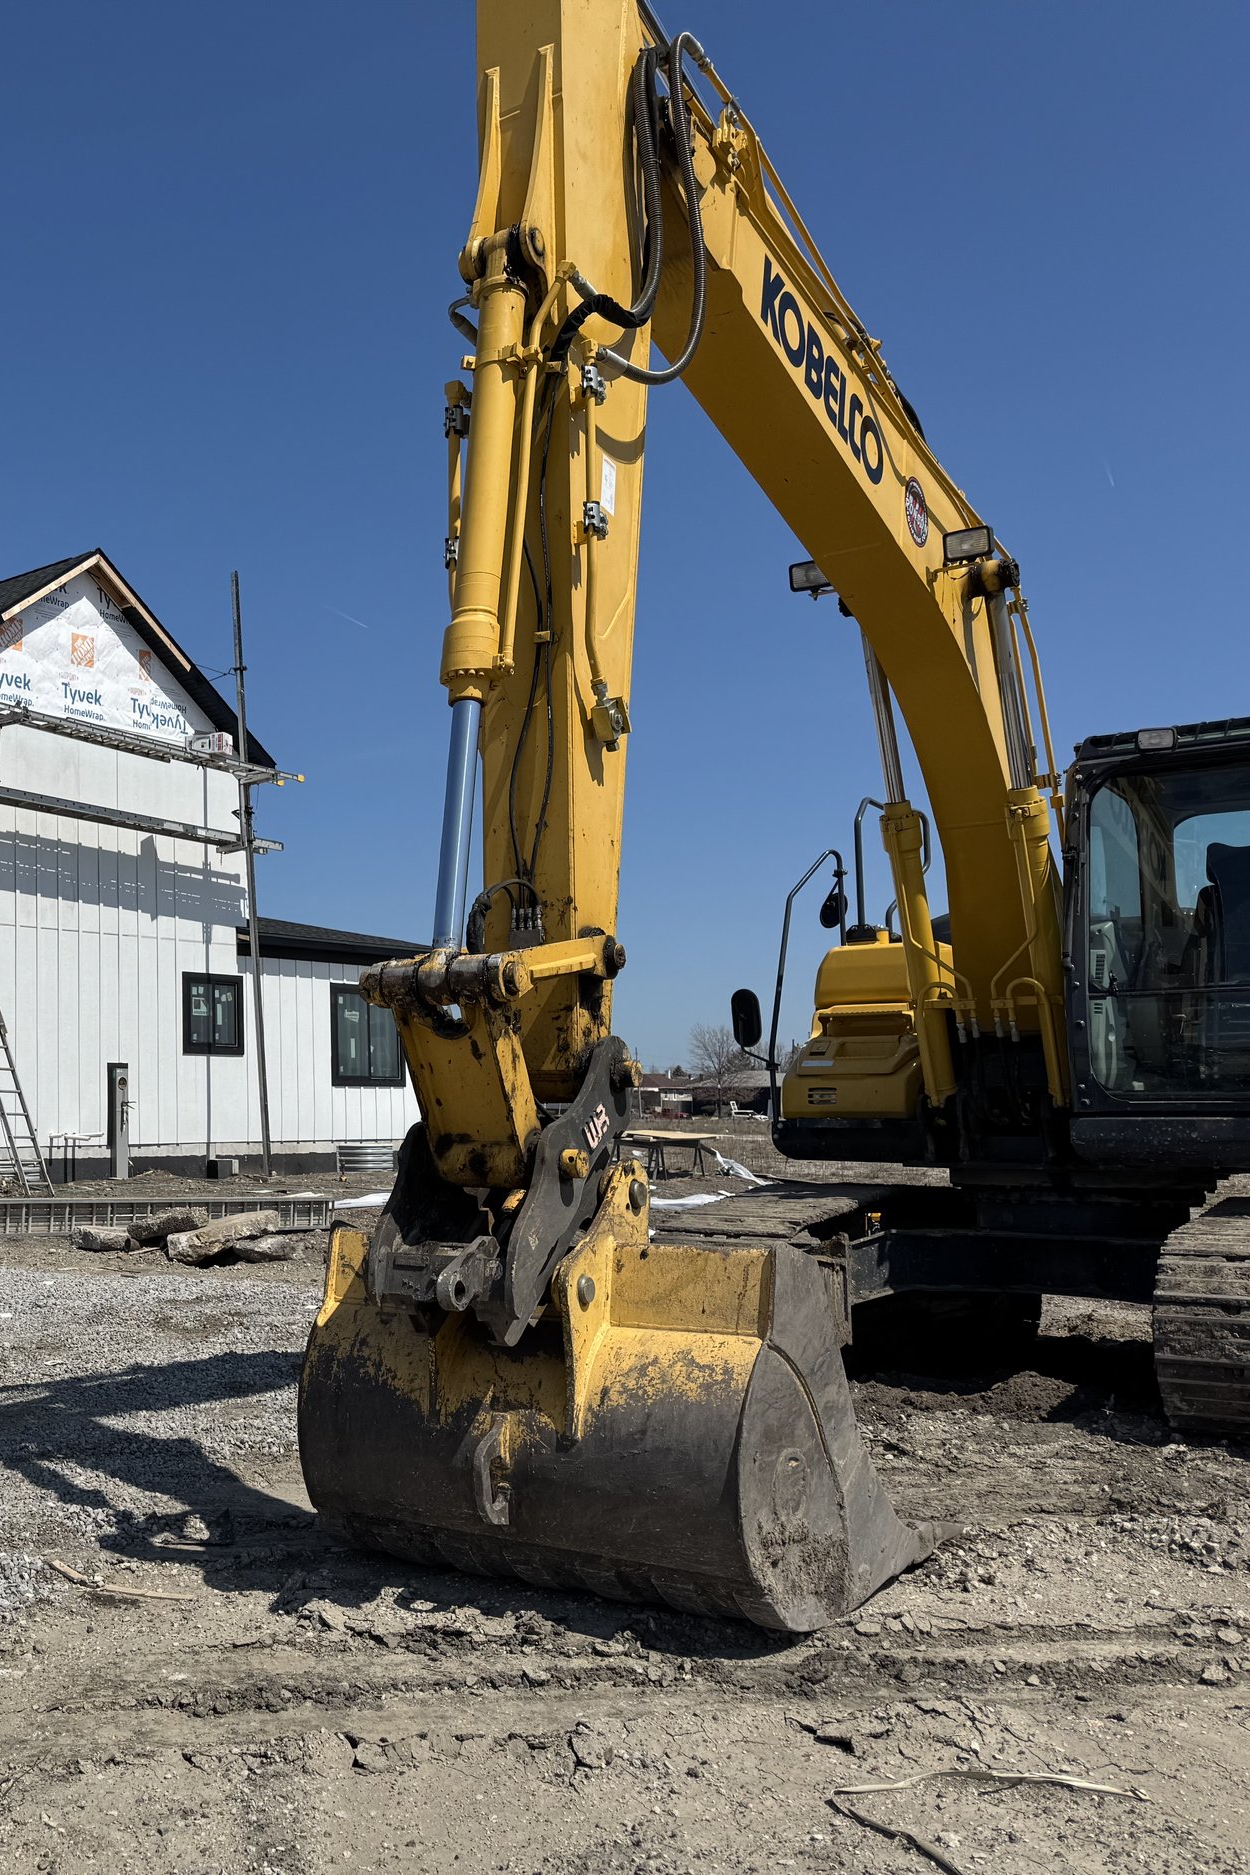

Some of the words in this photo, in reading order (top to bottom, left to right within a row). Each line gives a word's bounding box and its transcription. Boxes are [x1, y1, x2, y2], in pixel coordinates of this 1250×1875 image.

[760, 253, 884, 485] KOBELCO
[61, 681, 102, 706] Tyvek
[64, 704, 104, 721] HomeWrap
[130, 697, 151, 719] Tyv
[152, 712, 188, 735] Tyvek
